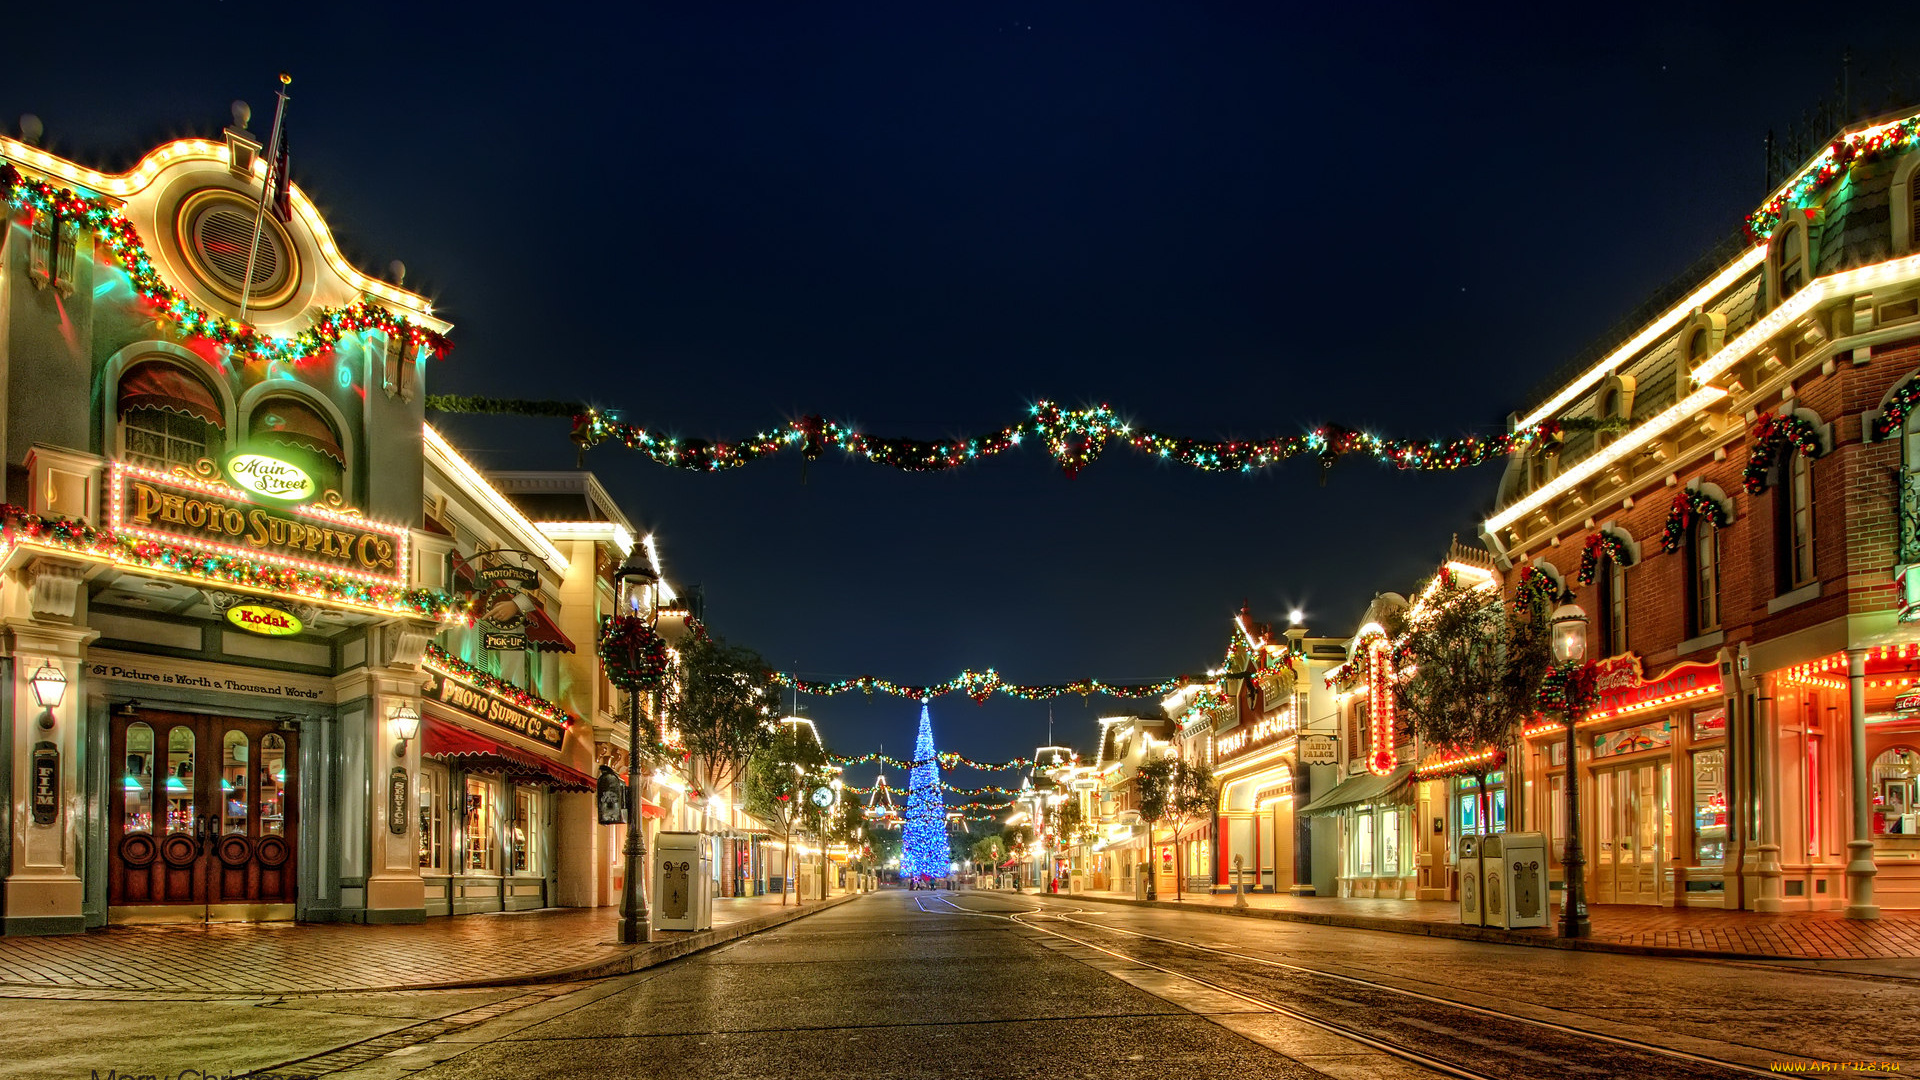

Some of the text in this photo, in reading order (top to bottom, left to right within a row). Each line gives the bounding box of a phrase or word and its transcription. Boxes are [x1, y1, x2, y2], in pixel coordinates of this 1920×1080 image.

[233, 459, 298, 476] Main
[254, 474, 308, 495] Street
[134, 482, 245, 536] PHOTO
[246, 508, 355, 559] SUPPLY
[241, 610, 290, 628] Kodak
[488, 636, 522, 646] PICK-UP
[111, 666, 160, 681] Picture
[163, 674, 174, 683] is
[175, 674, 211, 688] Worth
[213, 681, 223, 689] a
[224, 680, 281, 695] Thousand
[1638, 674, 1696, 700] CORNER
[441, 678, 488, 713] PHOTO
[489, 700, 528, 729] SUPPLY
[1217, 710, 1290, 756] PENNY ARCADE
[36, 767, 55, 805] FILM
[393, 781, 405, 825] SERVICE
